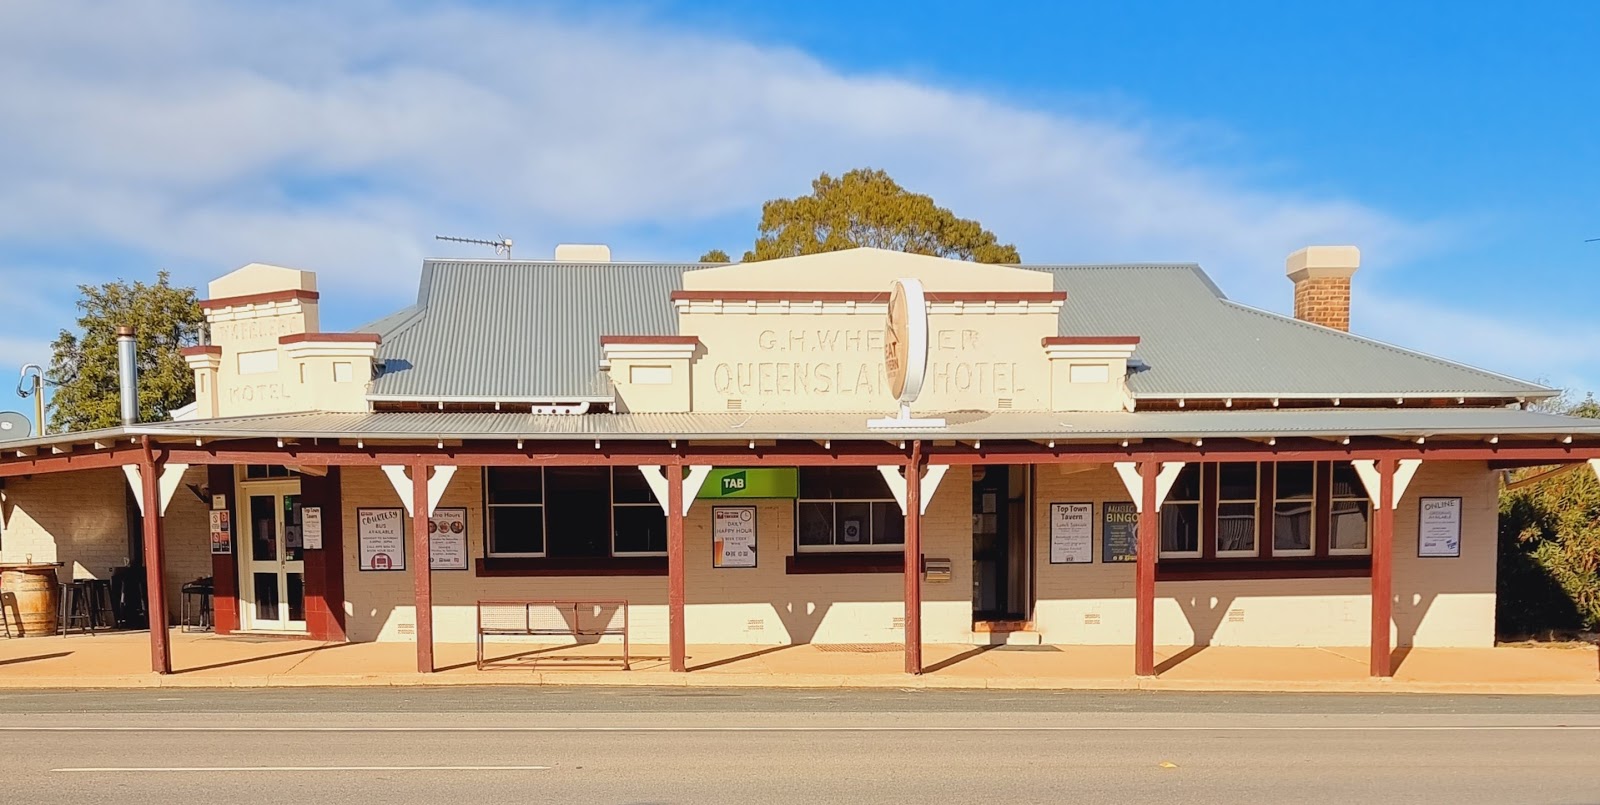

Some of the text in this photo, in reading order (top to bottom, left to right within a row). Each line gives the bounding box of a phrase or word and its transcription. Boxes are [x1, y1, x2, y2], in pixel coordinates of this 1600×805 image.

[714, 362, 1025, 395] QUEENSLAN HOTEL
[724, 478, 744, 488] TAB
[1425, 500, 1455, 510] ONLINE
[362, 511, 398, 525] COURTESY
[1106, 513, 1138, 522] BINGO
